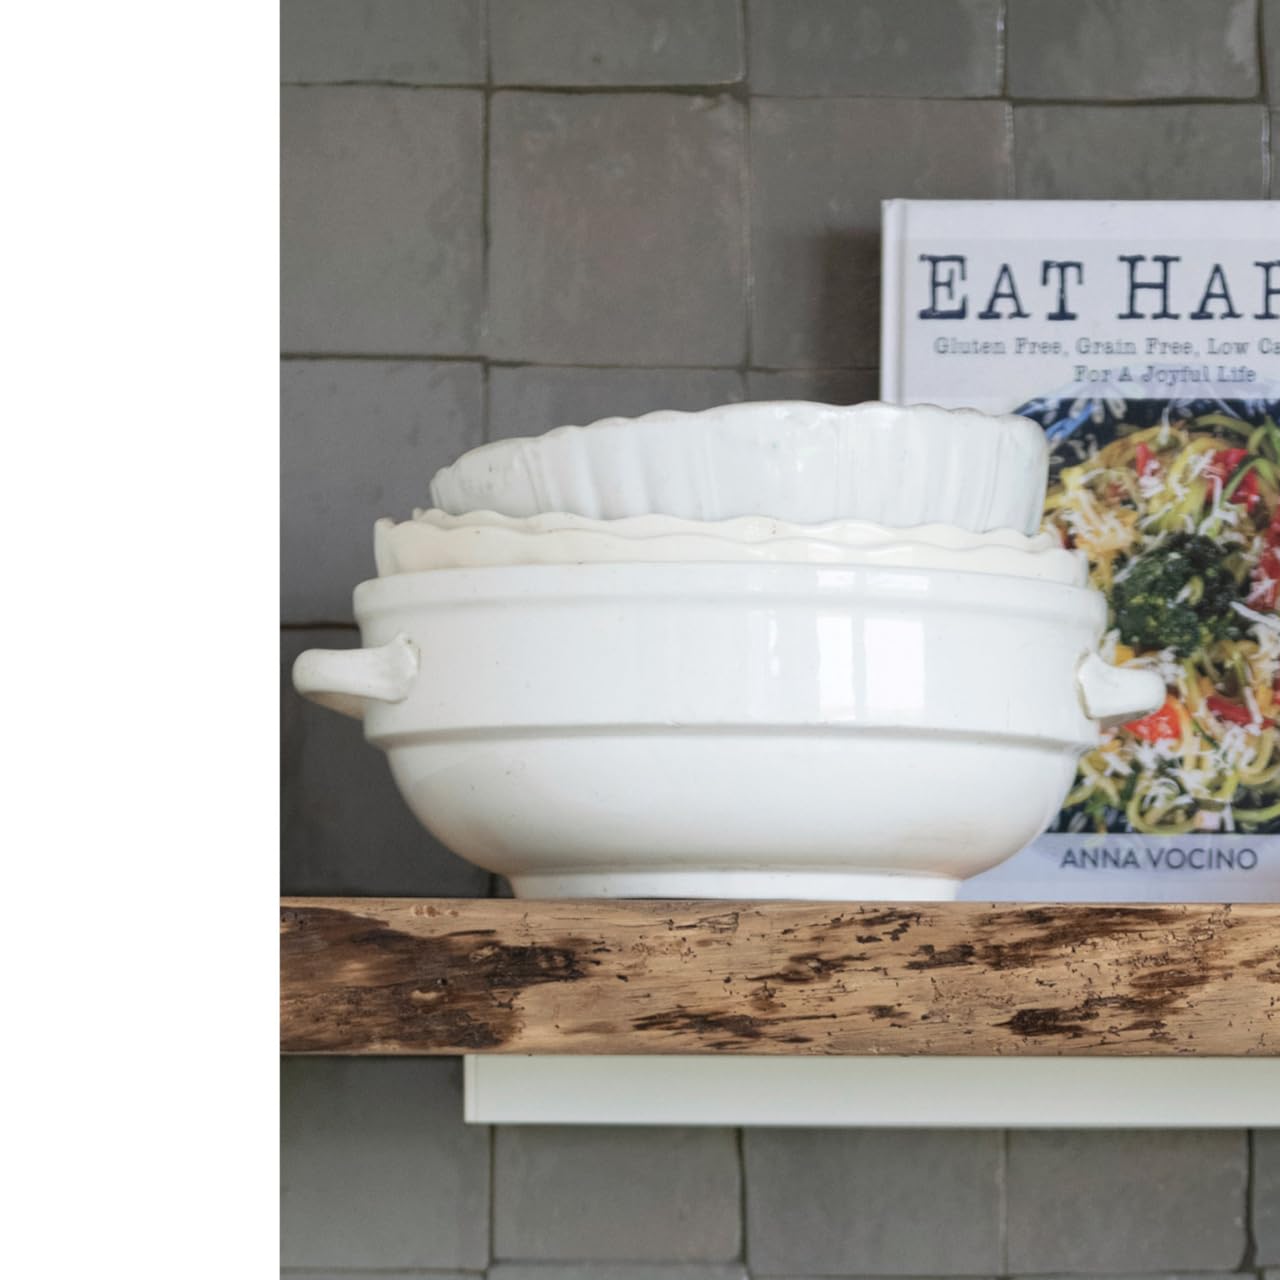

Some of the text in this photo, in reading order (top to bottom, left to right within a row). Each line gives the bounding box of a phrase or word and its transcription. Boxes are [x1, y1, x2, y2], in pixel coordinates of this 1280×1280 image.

[917, 254, 1084, 321] EAT
[933, 336, 1006, 355] Gluten
[1014, 336, 1070, 357] Free,
[1075, 336, 1137, 355] Grain
[1145, 337, 1200, 357] Free,
[1206, 337, 1250, 355] Low
[1073, 364, 1257, 386] For A Joyful Life
[1060, 847, 1259, 870] ANNA VOCINO
